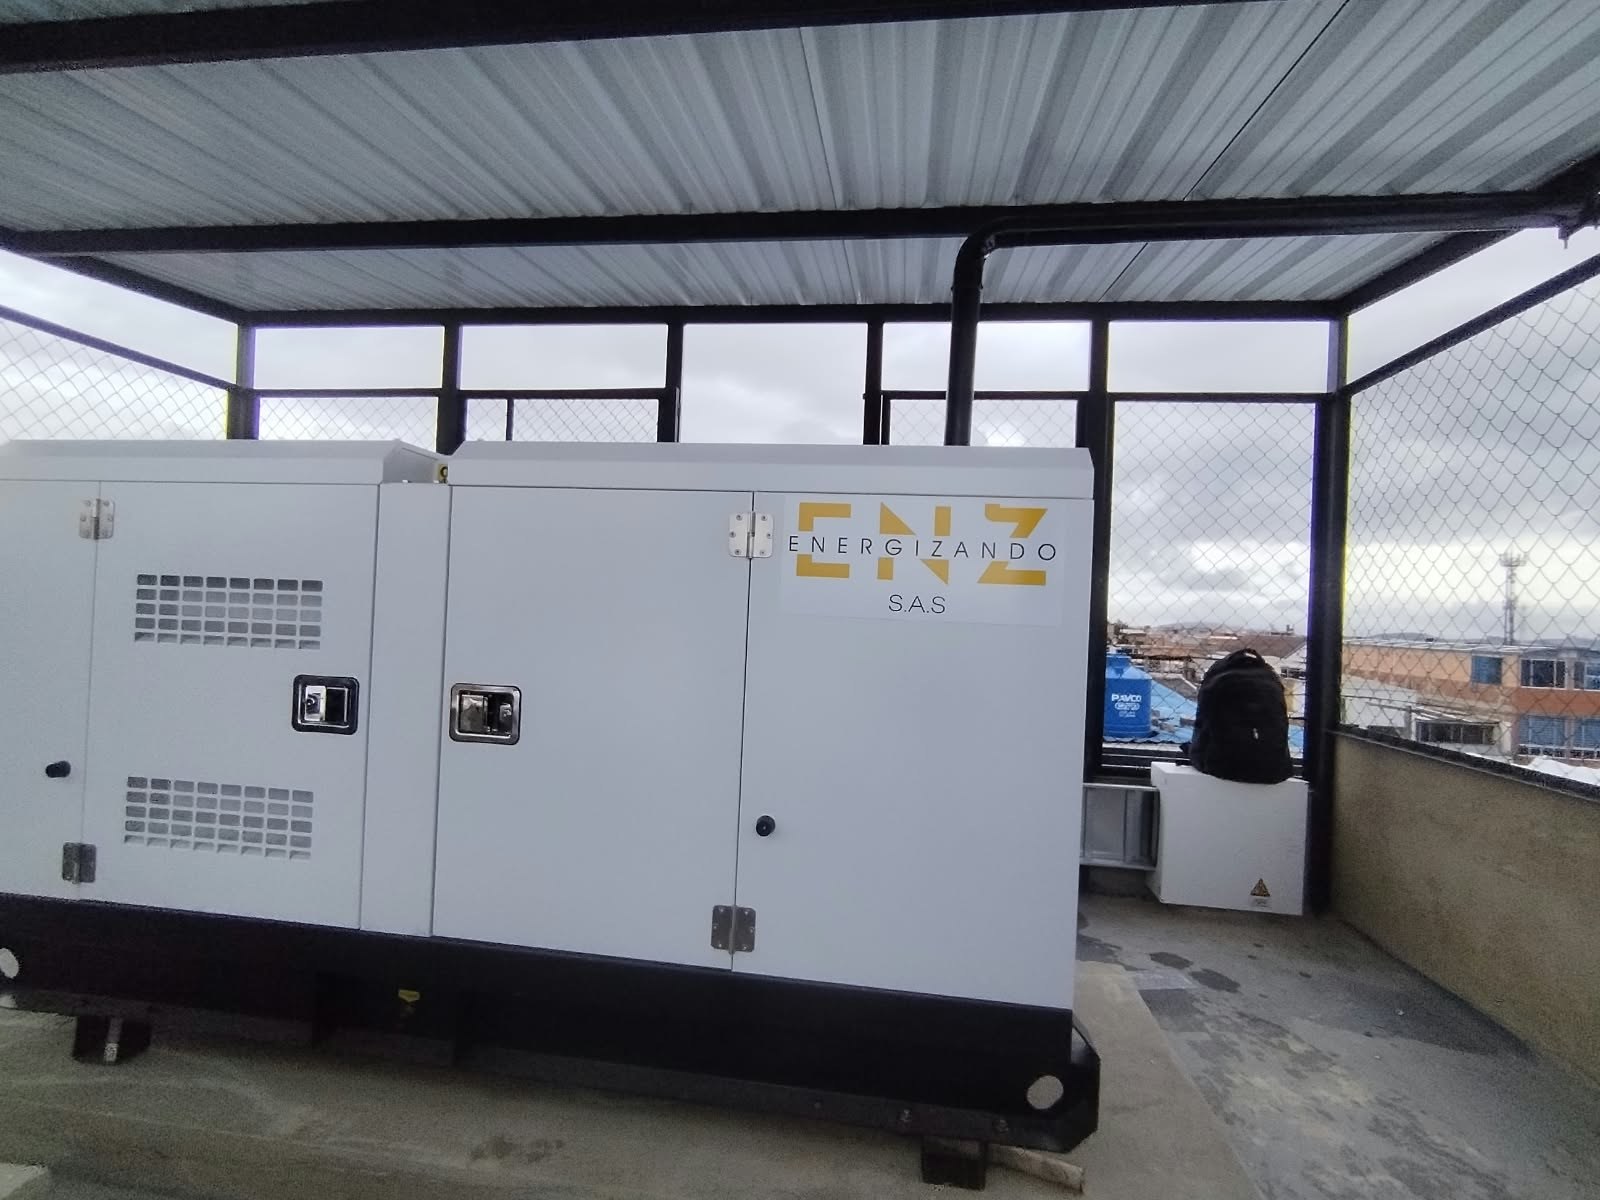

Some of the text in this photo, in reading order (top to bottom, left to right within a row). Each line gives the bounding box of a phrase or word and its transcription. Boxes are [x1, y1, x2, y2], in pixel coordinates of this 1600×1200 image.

[788, 535, 1056, 561] ENERGIZANDO
[888, 594, 946, 614] S.A.S
[1111, 693, 1142, 703] PAVCO
